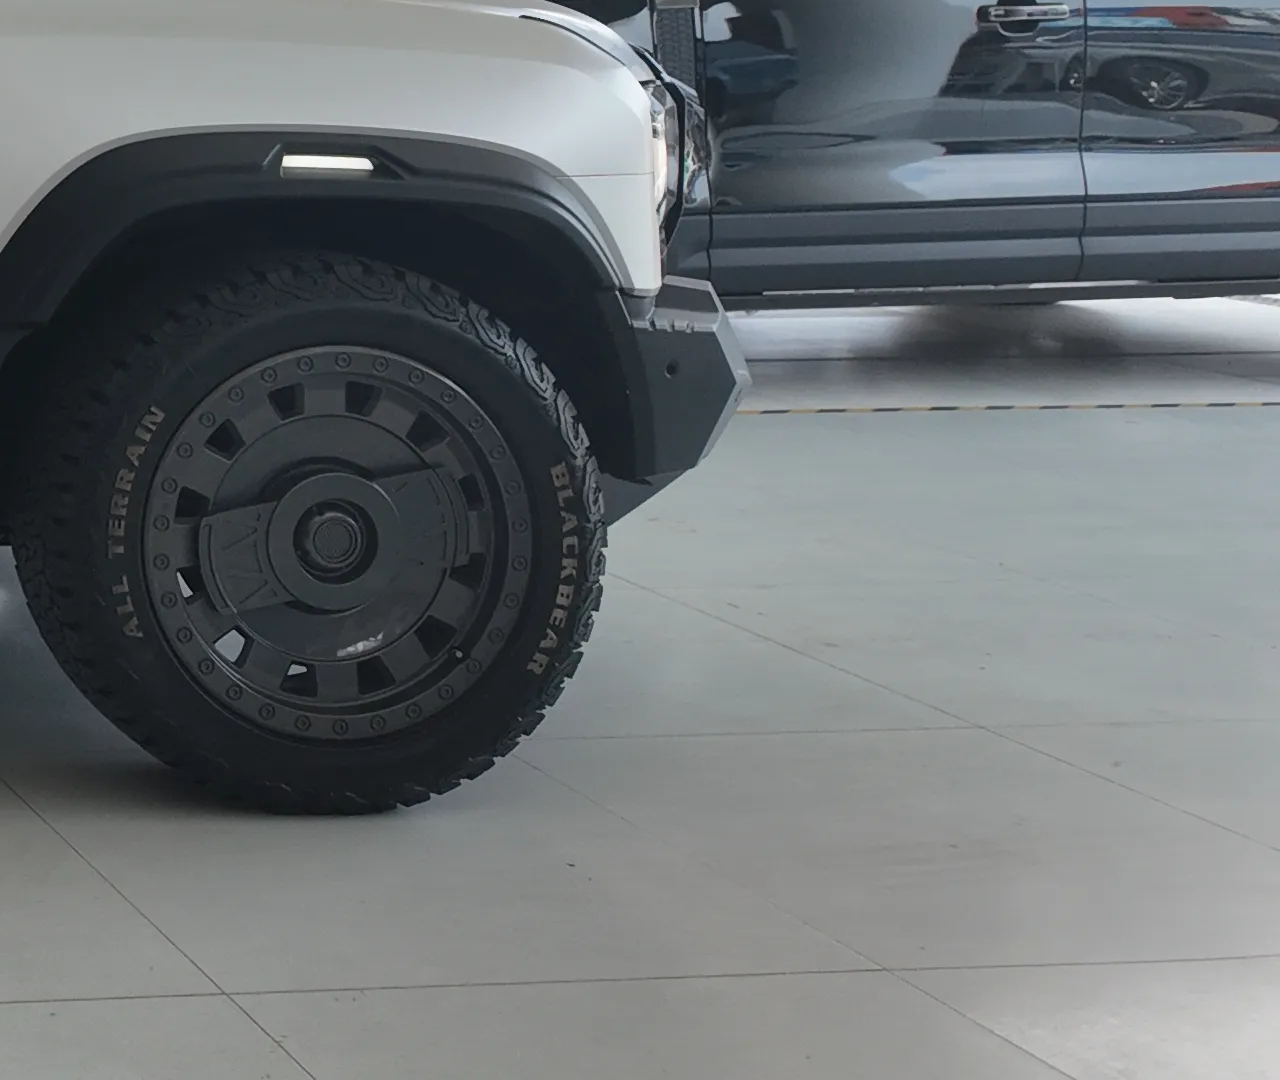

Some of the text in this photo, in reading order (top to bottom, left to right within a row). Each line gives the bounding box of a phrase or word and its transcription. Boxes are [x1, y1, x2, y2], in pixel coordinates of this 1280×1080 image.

[107, 404, 166, 638] ALL TERRAIN
[526, 460, 579, 675] BLACKBEAR
